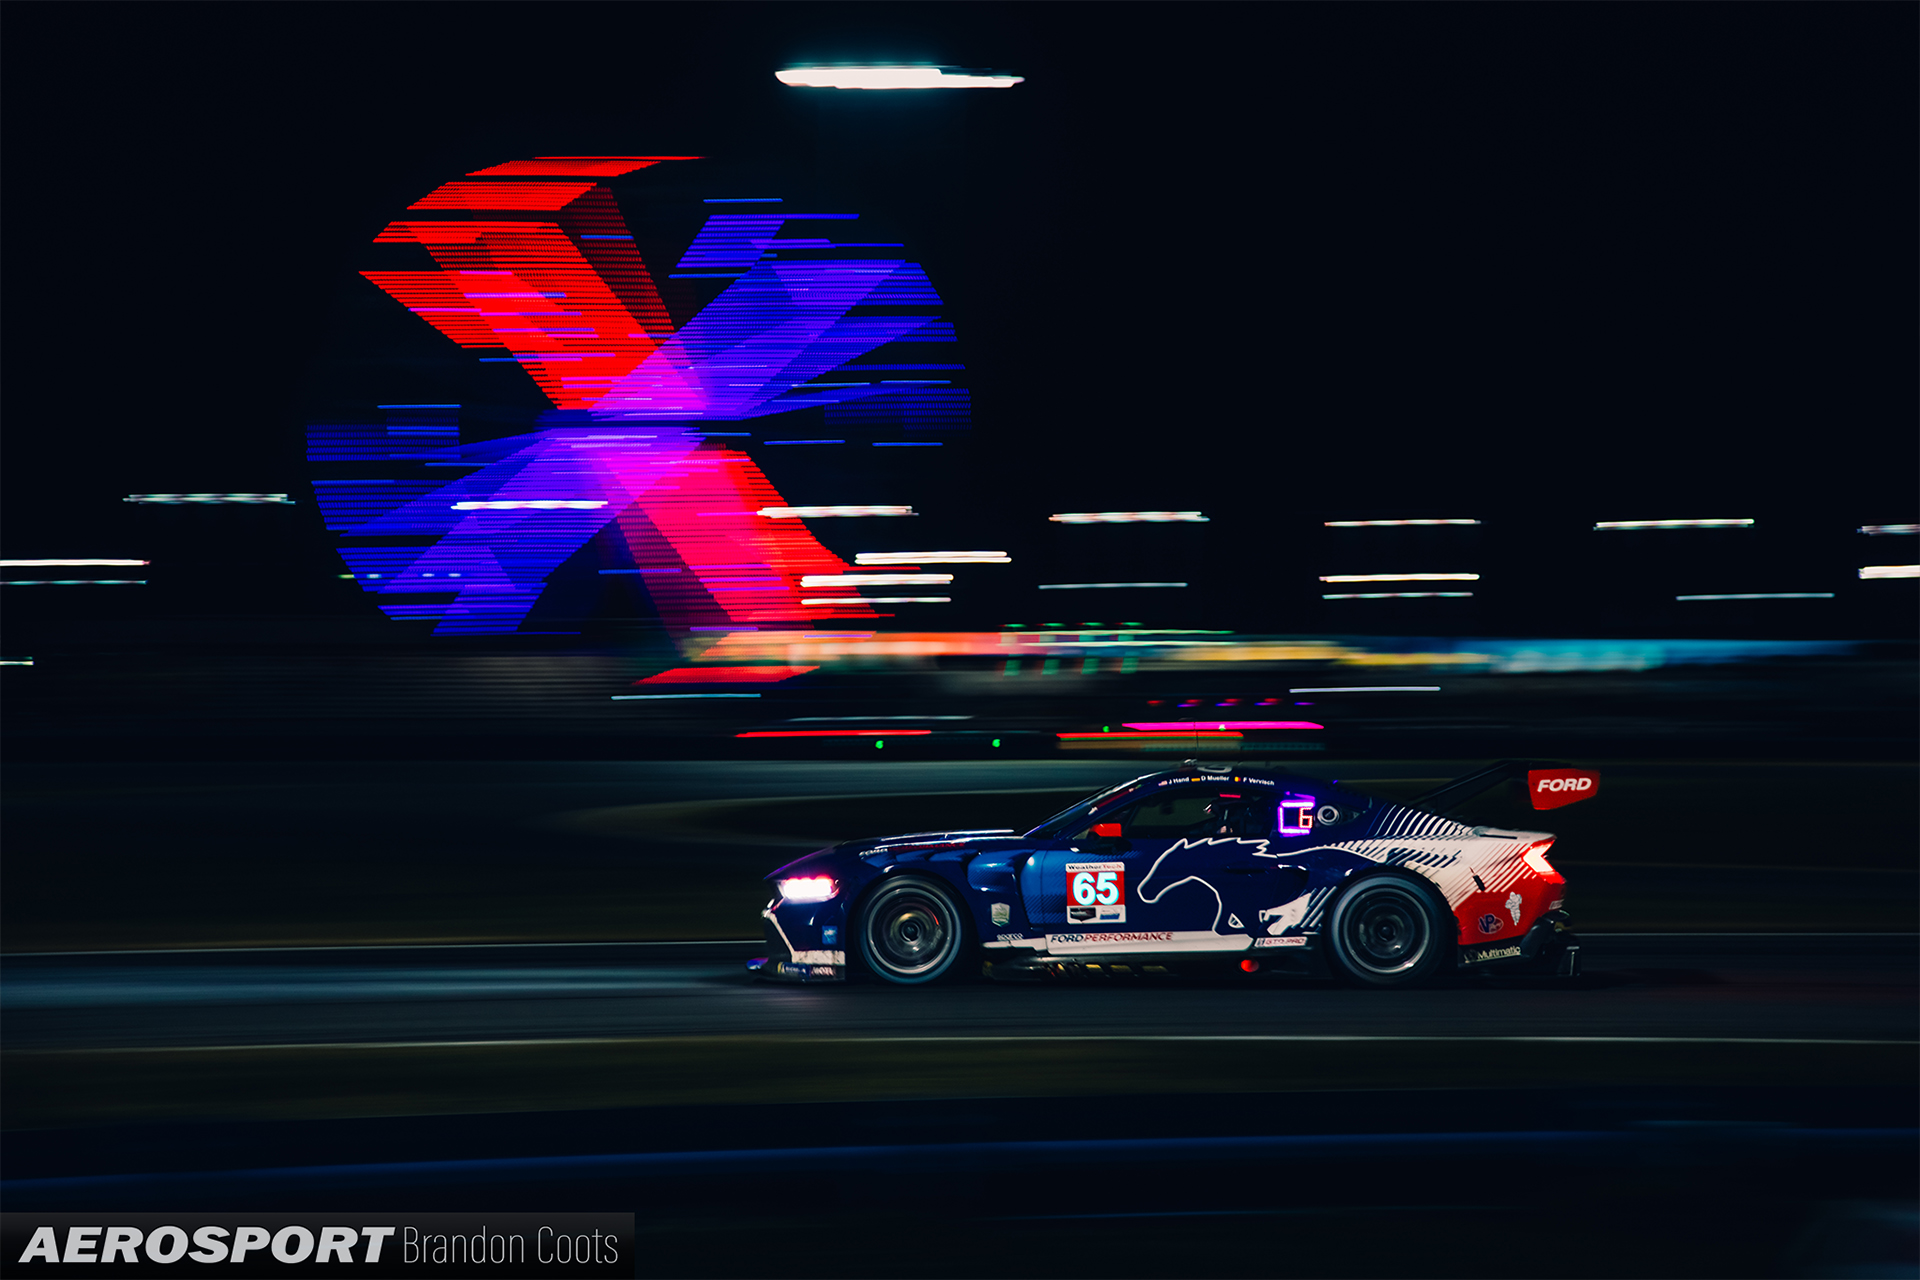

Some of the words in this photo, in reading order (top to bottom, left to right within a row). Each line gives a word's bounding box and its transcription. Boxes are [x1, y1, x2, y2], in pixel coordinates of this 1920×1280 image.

[1173, 776, 1190, 784] Hand
[1248, 777, 1275, 786] Vervisch
[1537, 777, 1592, 793] FORD
[1072, 872, 1120, 906] 65
[1478, 946, 1521, 960] Multimatic
